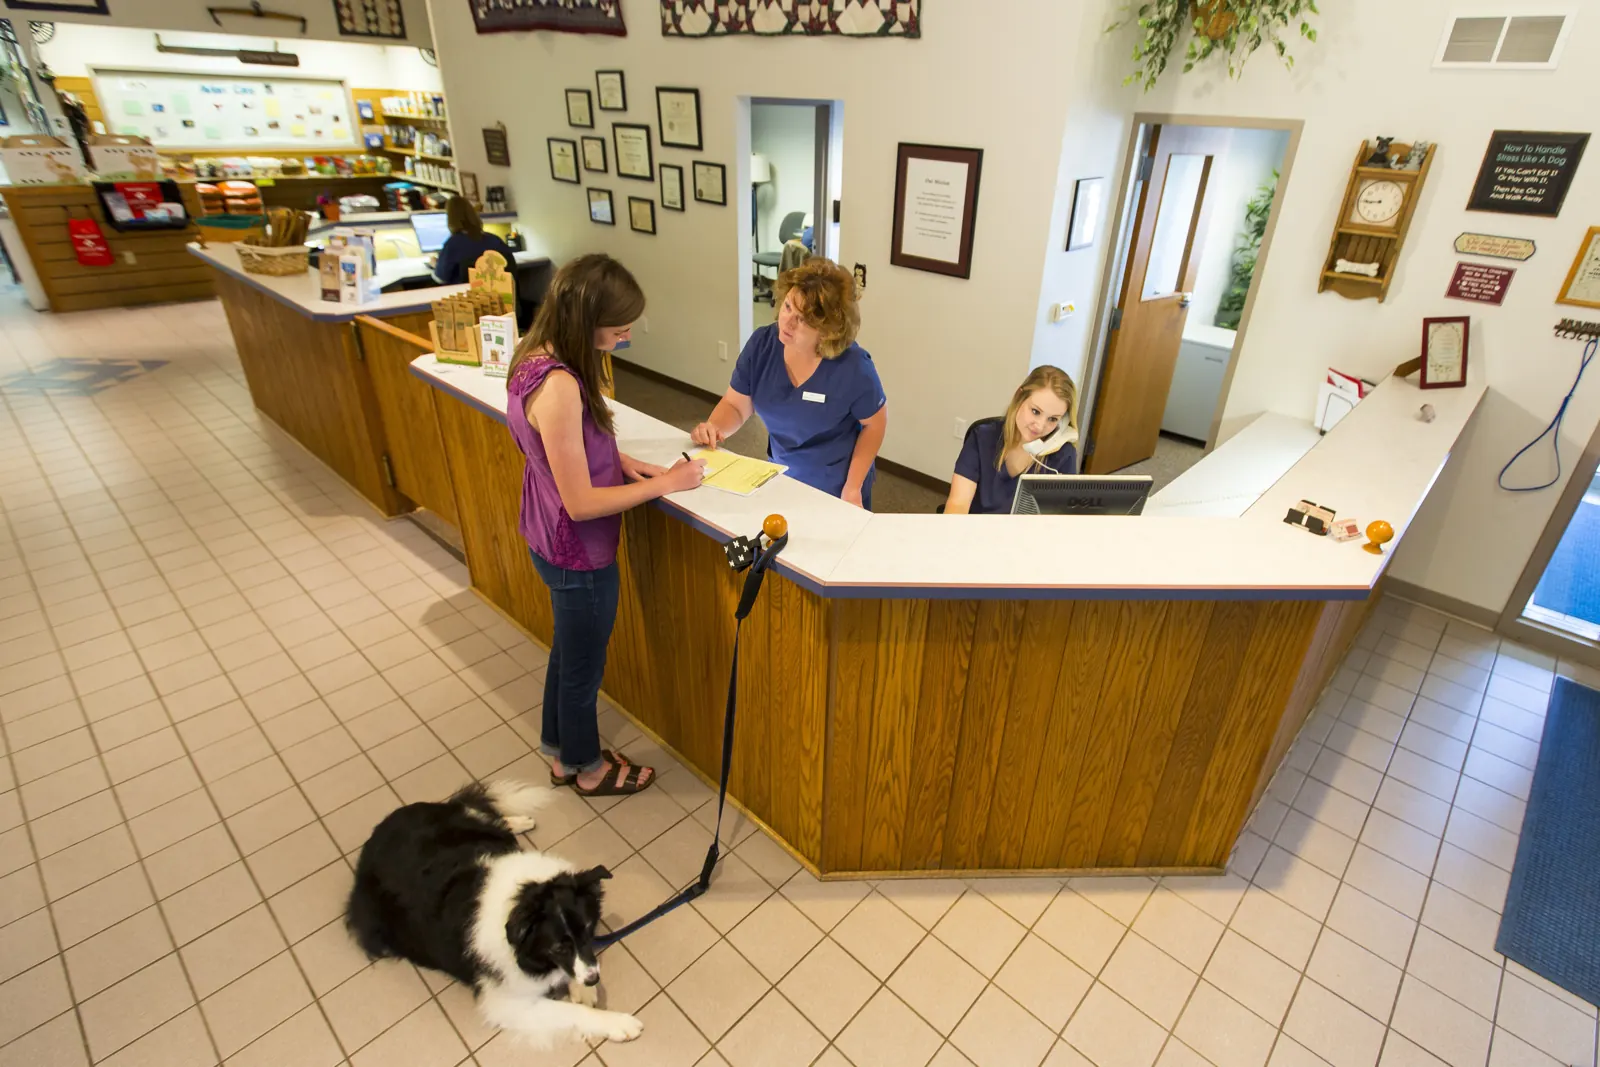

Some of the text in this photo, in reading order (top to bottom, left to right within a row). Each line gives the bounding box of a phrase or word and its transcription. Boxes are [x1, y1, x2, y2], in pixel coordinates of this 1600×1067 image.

[1504, 144, 1567, 155] How To Handle
[1496, 153, 1567, 167] Stress Like A Dog
[1503, 167, 1516, 175] You
[1516, 168, 1537, 176] Can't
[1537, 169, 1550, 177] Eat
[1507, 175, 1523, 183] Play
[1510, 186, 1524, 194] Pee
[1522, 195, 1544, 203] Away
[1067, 496, 1103, 507] DELL
